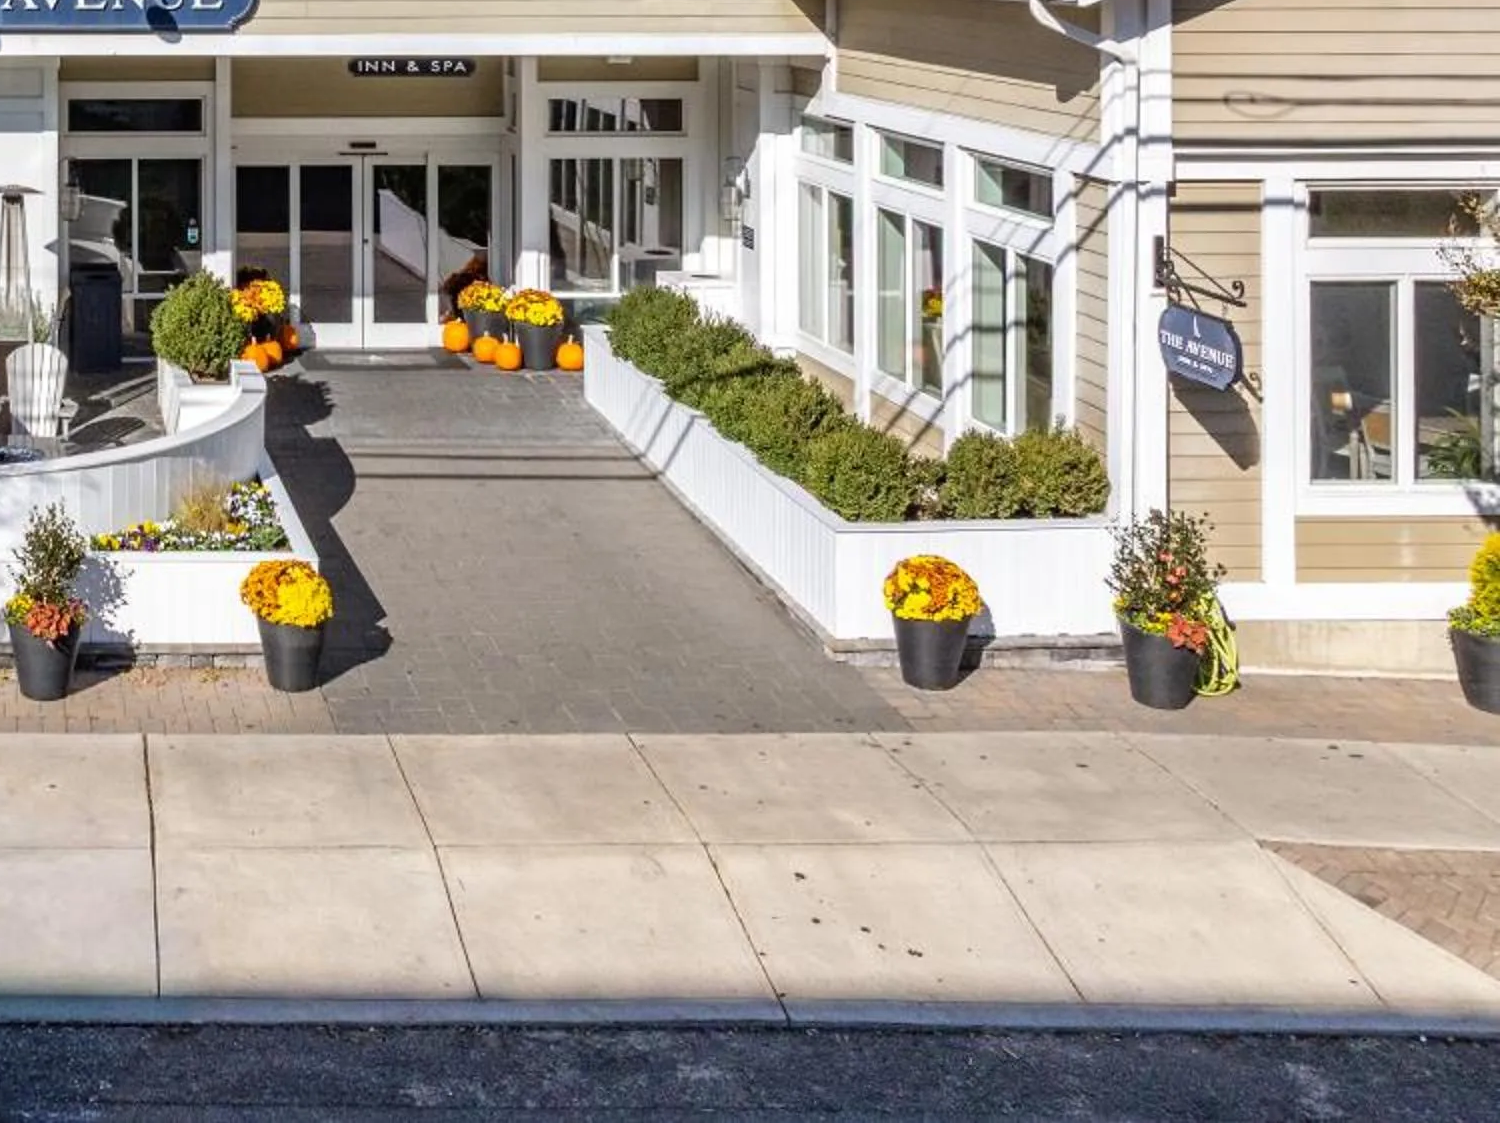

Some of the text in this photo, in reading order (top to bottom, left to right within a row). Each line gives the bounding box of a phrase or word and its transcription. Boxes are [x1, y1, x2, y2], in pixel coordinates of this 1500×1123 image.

[357, 60, 466, 72] INN & SPA
[1160, 329, 1184, 350] THE
[1185, 340, 1235, 370] AVENUE
